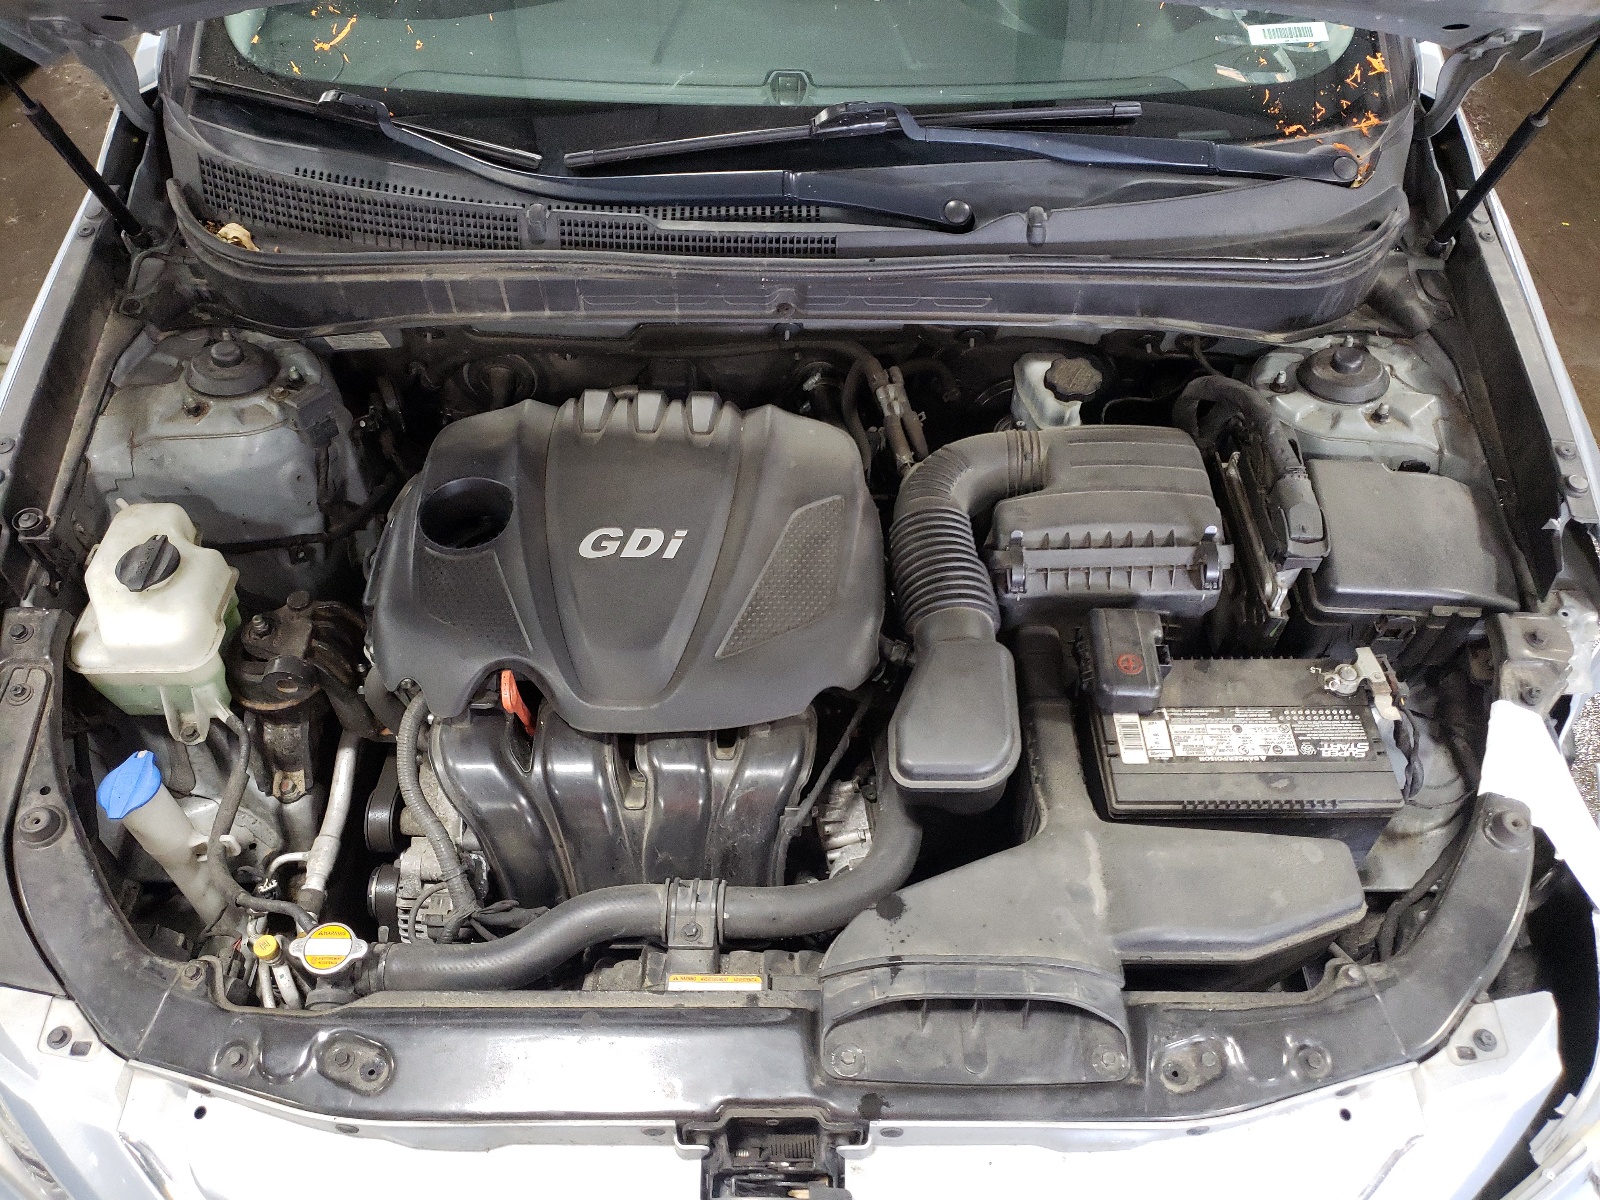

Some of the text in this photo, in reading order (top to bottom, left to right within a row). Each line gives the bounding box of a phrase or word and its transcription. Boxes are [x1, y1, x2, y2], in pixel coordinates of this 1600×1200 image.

[578, 527, 688, 559] GDi
[1320, 742, 1369, 752] START
[1321, 750, 1366, 758] SUPER
